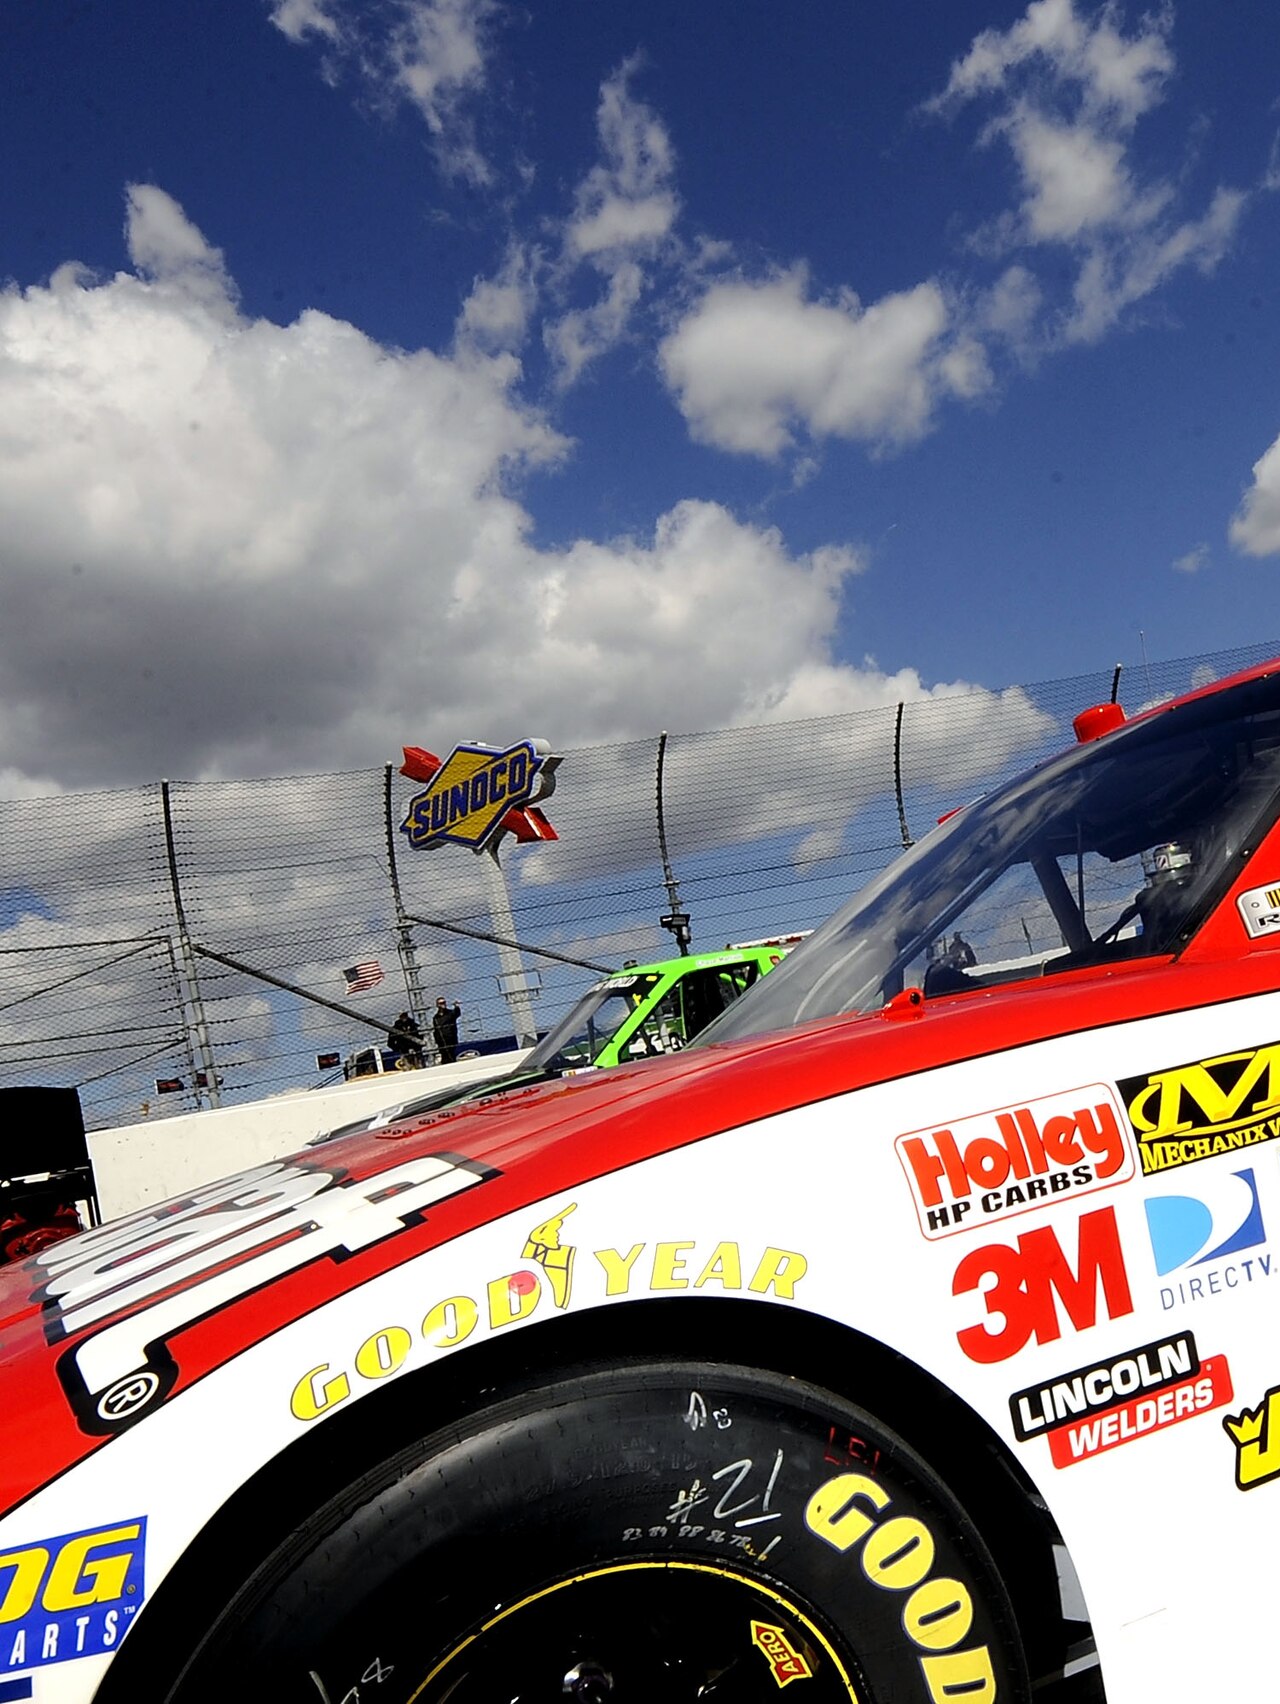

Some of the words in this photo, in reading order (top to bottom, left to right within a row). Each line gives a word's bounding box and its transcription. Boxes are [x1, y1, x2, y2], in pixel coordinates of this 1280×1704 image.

[412, 751, 528, 834] SUNOCO
[902, 1103, 1125, 1207] Holley
[1138, 1122, 1268, 1174] MECHANIX
[927, 1201, 971, 1231] HP
[981, 1165, 1093, 1214] CARBS
[952, 1206, 1134, 1363] 3M
[1160, 1254, 1272, 1311] DIRECTV
[1018, 1338, 1192, 1431] LINCOLN
[1068, 1377, 1214, 1458] WELDERS
[9, 1610, 118, 1665] ARTS
[757, 1629, 800, 1675] AERO
